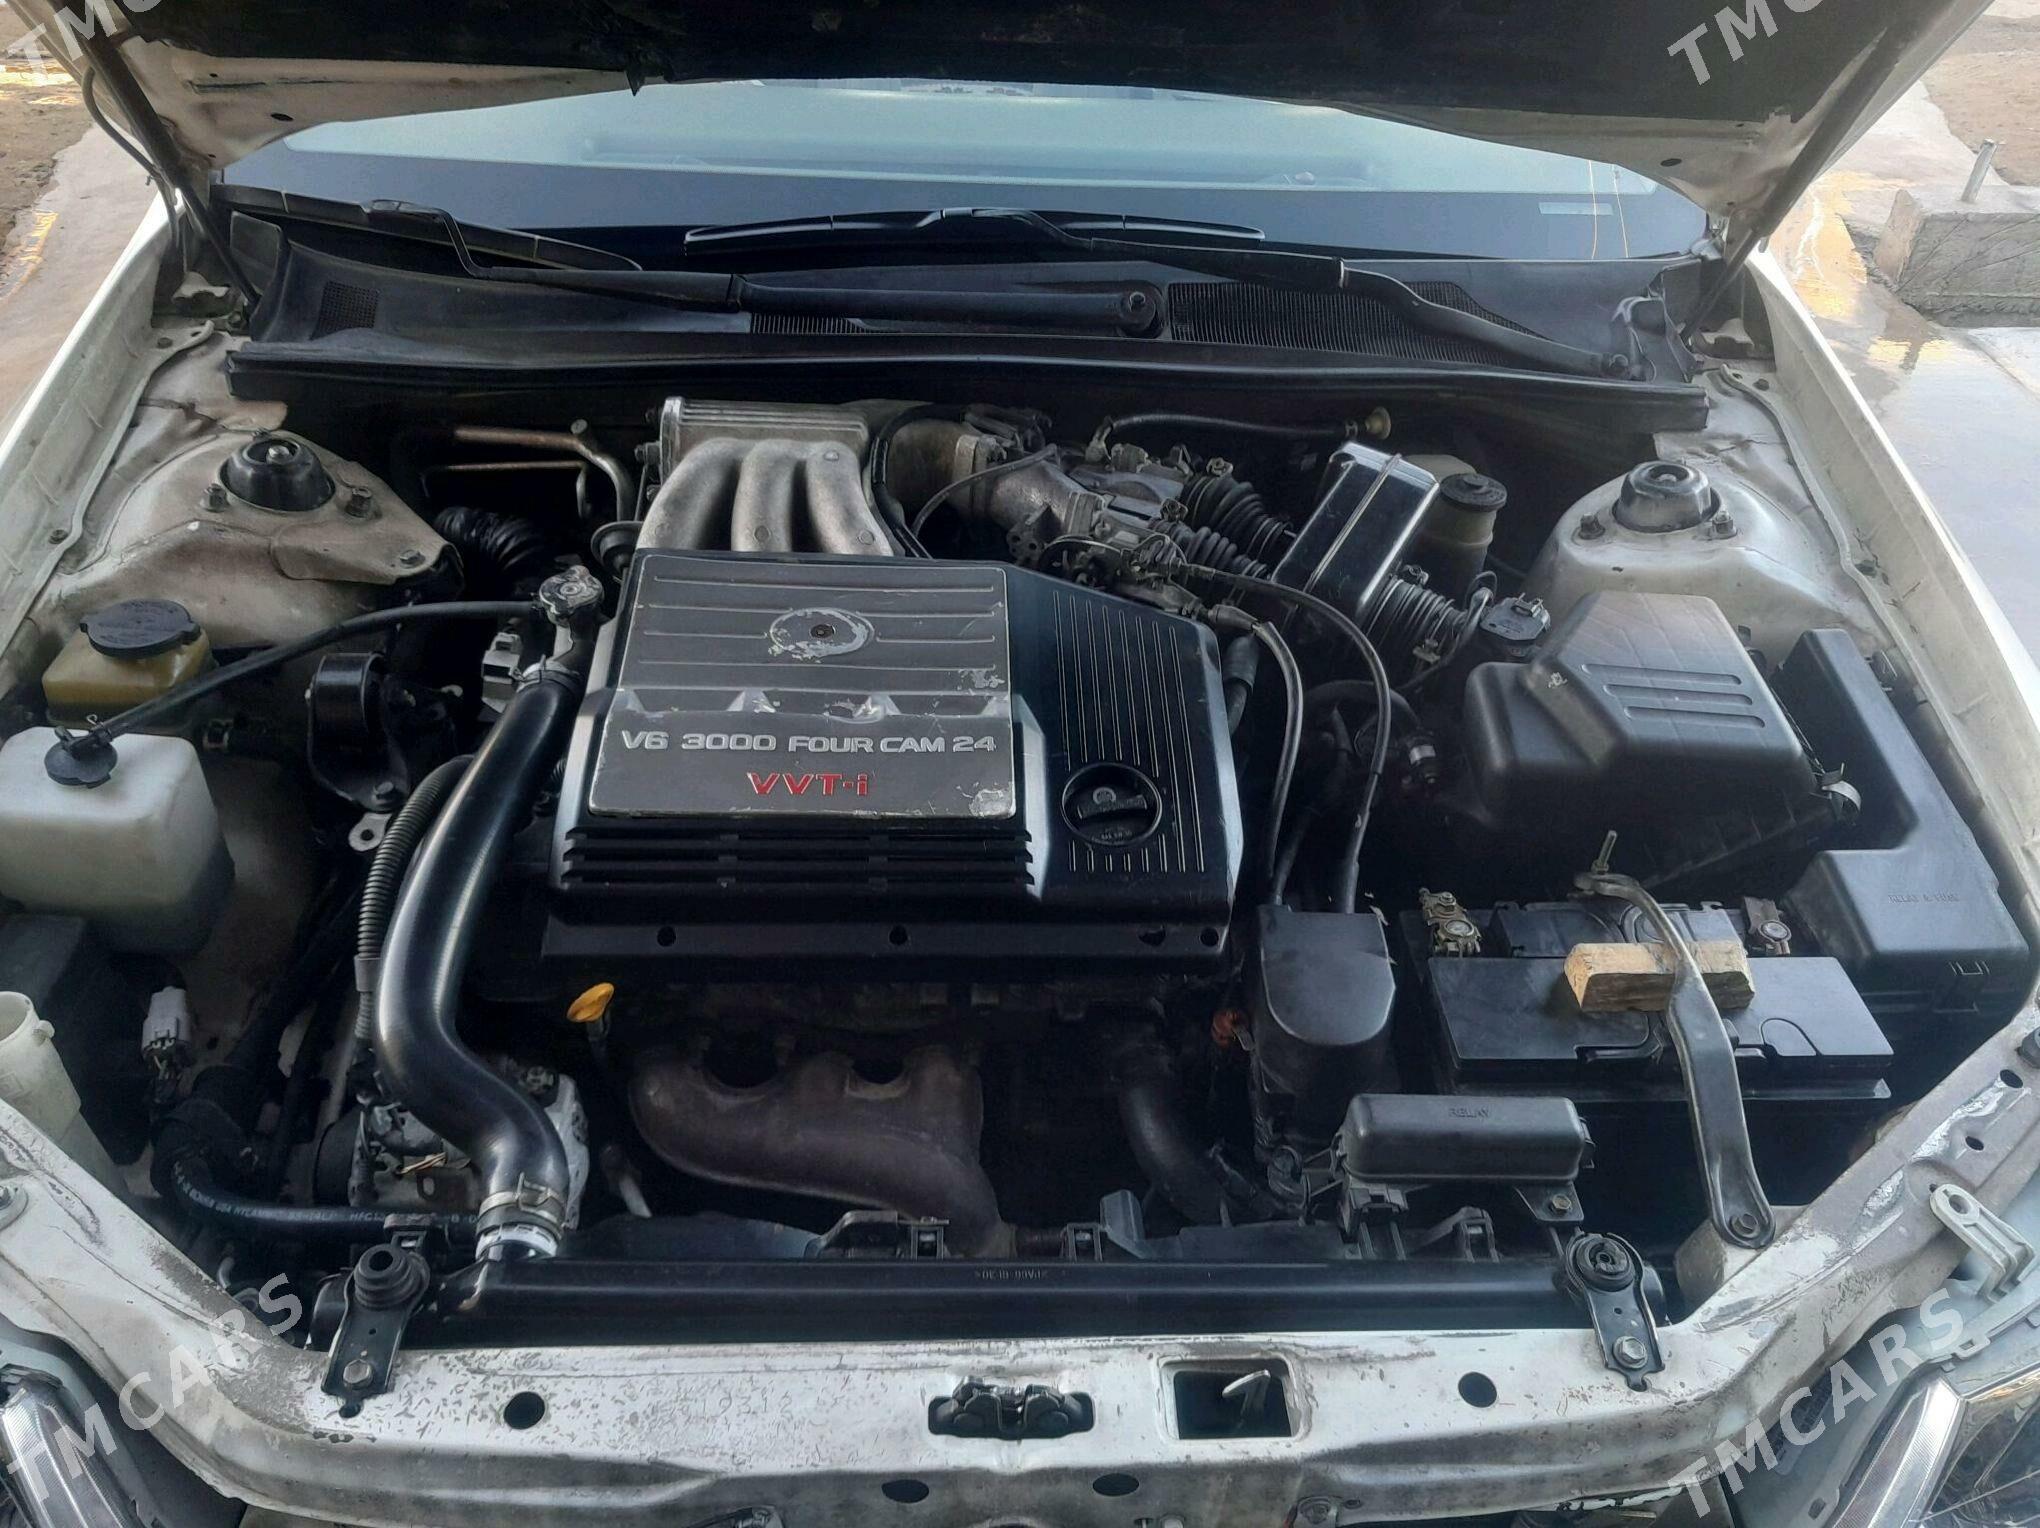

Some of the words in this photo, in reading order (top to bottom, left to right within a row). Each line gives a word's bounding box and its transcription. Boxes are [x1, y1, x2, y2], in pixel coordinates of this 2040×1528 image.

[621, 730, 669, 750] V6
[681, 733, 777, 752] 3000
[788, 735, 874, 753] FOUR
[880, 736, 945, 753] CAM
[952, 735, 997, 753] 24
[746, 772, 870, 796] VVT-i
